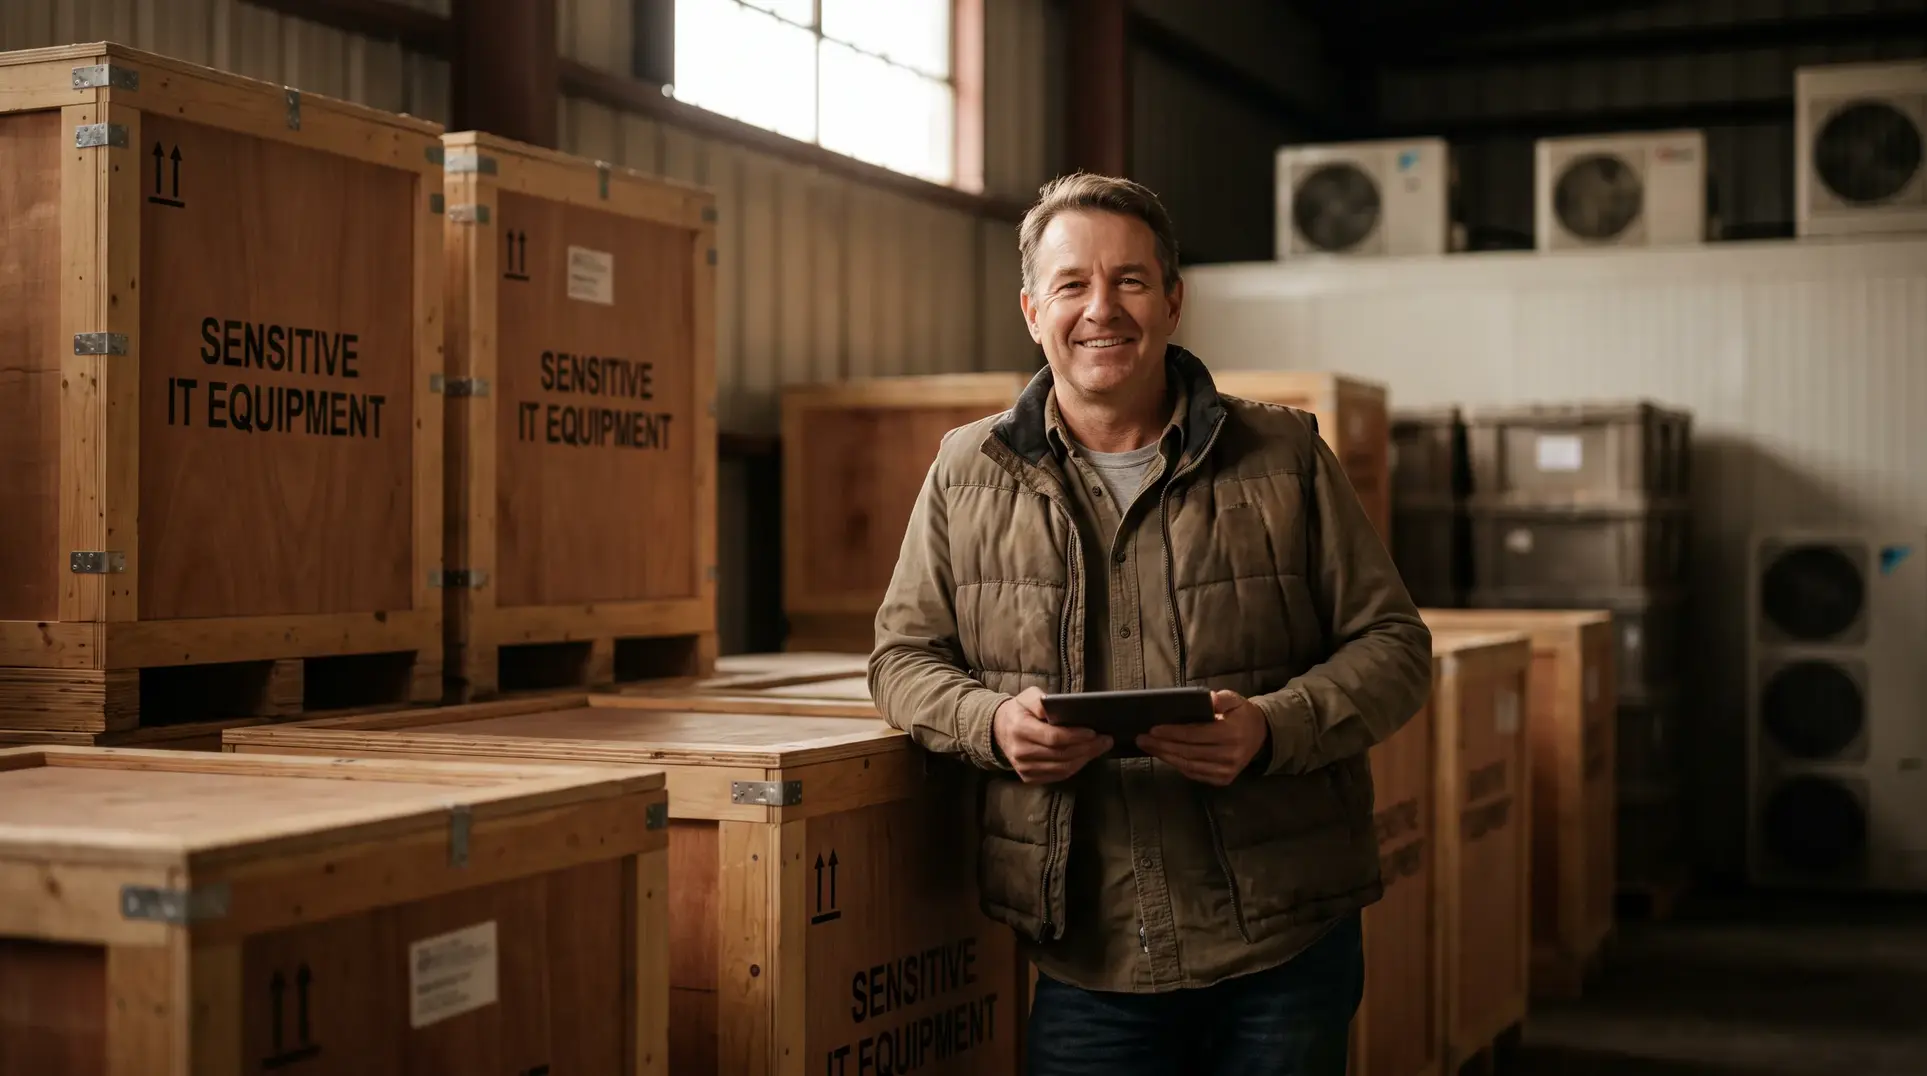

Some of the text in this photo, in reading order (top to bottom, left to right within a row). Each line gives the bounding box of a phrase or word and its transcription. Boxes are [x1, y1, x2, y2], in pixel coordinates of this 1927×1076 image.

[200, 316, 359, 378] SENSITIVE
[540, 350, 653, 400] SENSITIVE
[168, 377, 386, 439] IT EQUIPMENT
[519, 401, 672, 451] IT EQUIPMENT
[851, 937, 978, 1024] SENSITIVE
[858, 993, 998, 1076] EQUIPMENT
